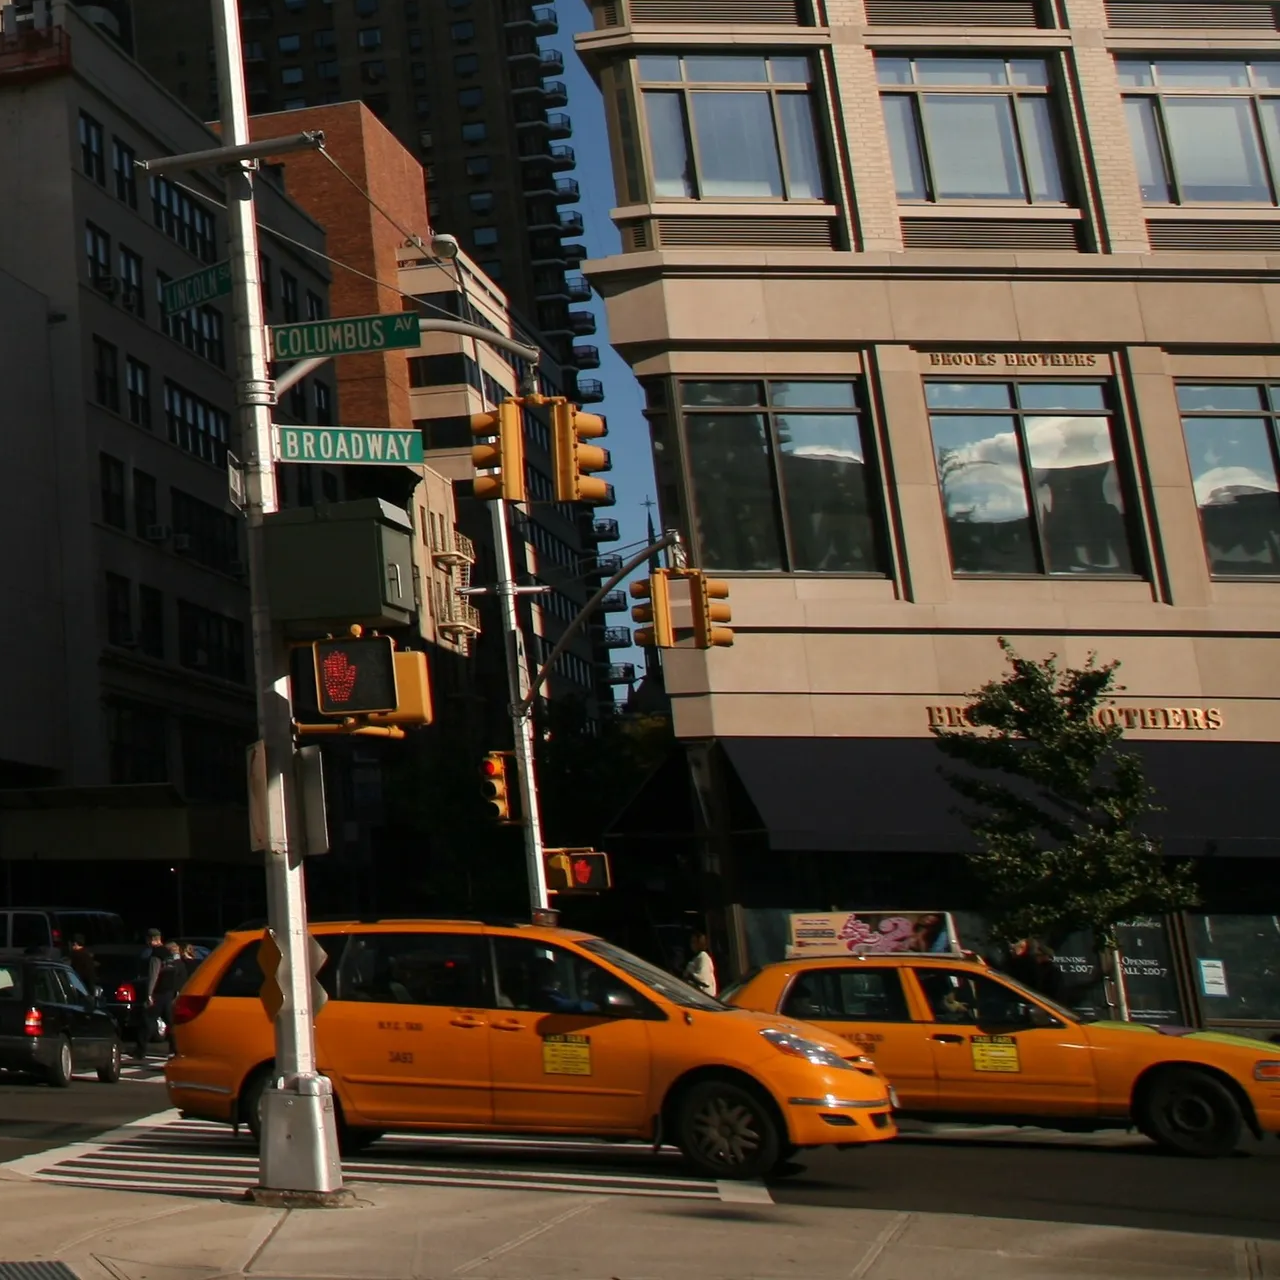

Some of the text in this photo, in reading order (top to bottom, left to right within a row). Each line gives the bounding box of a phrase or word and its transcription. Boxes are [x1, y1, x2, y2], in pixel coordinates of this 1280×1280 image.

[165, 271, 217, 312] LINCOLN
[275, 317, 412, 357] COLUMBUS AV
[930, 353, 1097, 367] BROOKS BROTHERS
[286, 432, 413, 461] BROADWAY
[1069, 965, 1093, 974] 2007
[1143, 968, 1167, 977] 2007
